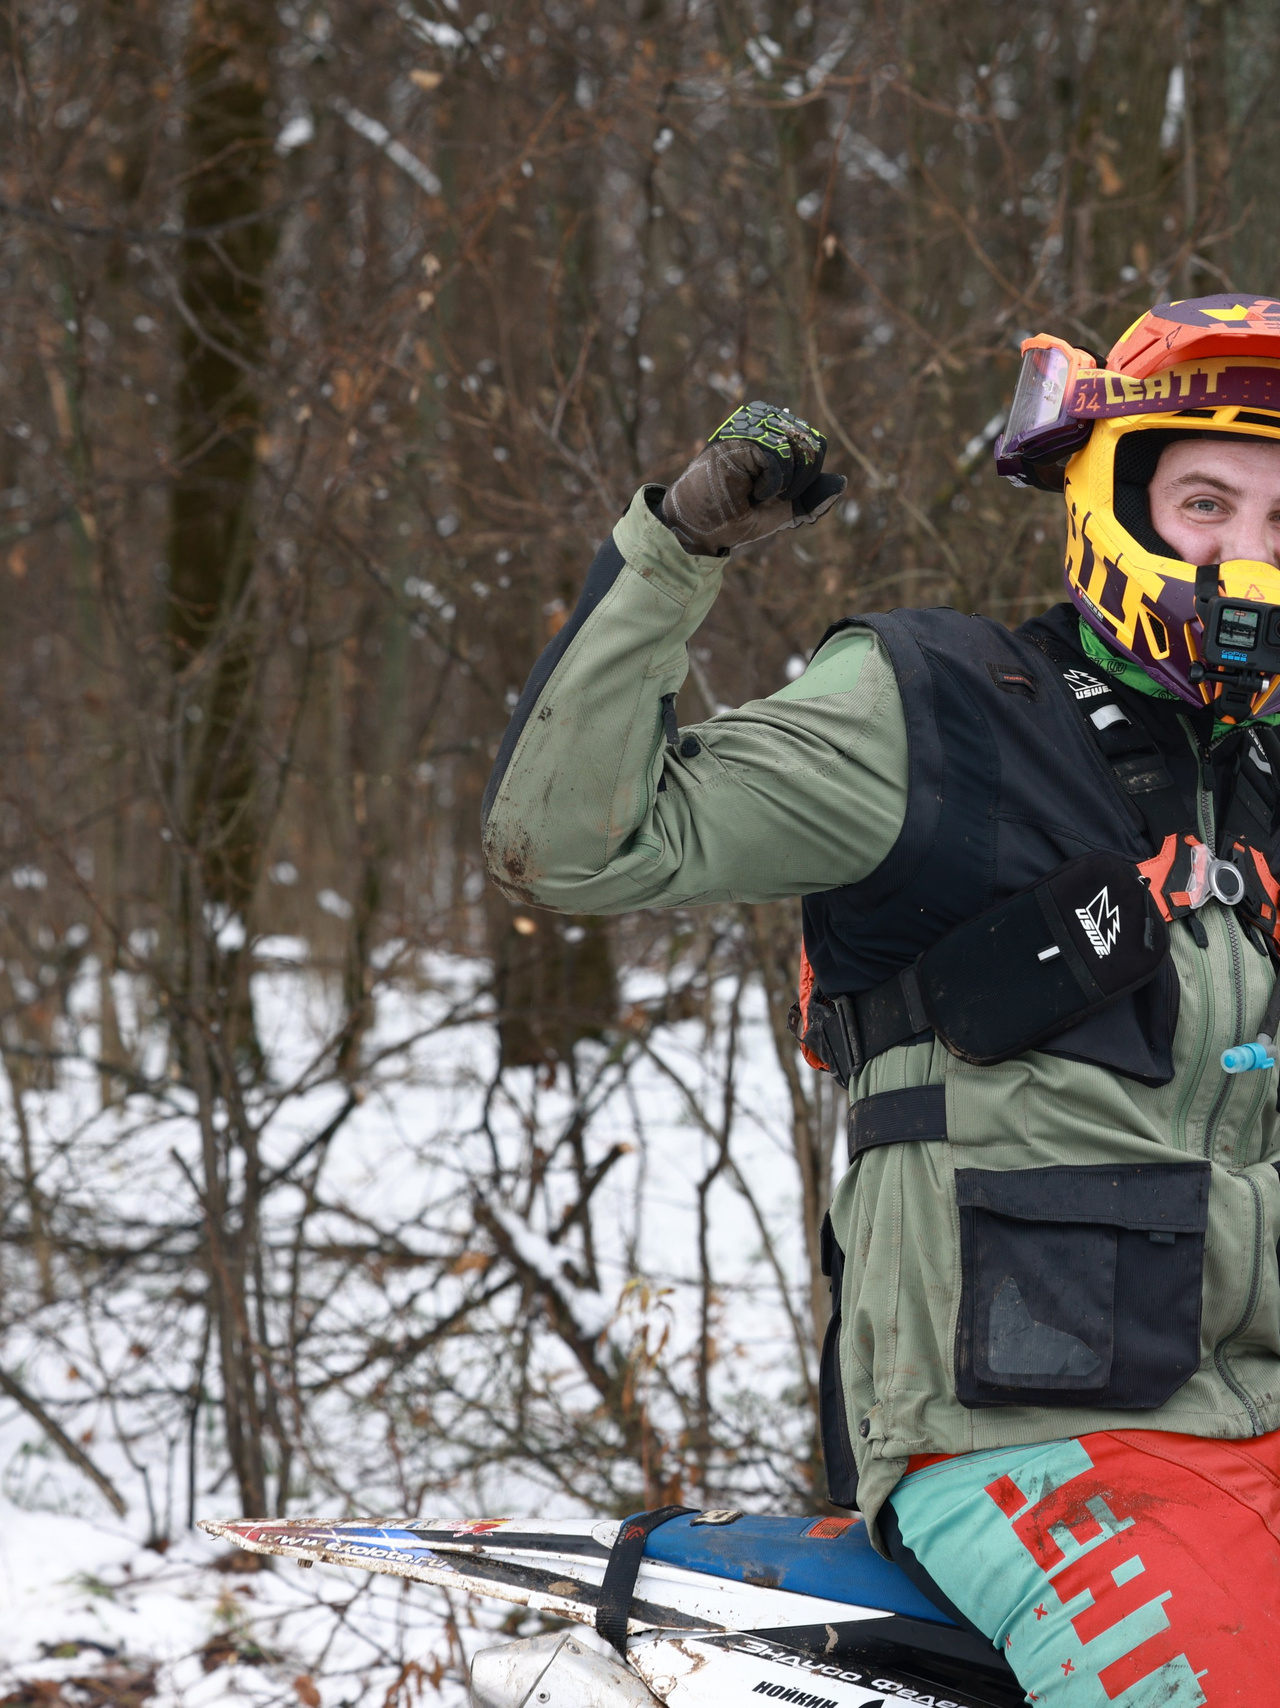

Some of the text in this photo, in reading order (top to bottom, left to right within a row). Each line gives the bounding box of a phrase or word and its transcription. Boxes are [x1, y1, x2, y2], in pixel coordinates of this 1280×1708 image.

[1105, 365, 1227, 405] LEATT
[1221, 649, 1248, 658] GoPro
[1074, 908, 1110, 957] USWE
